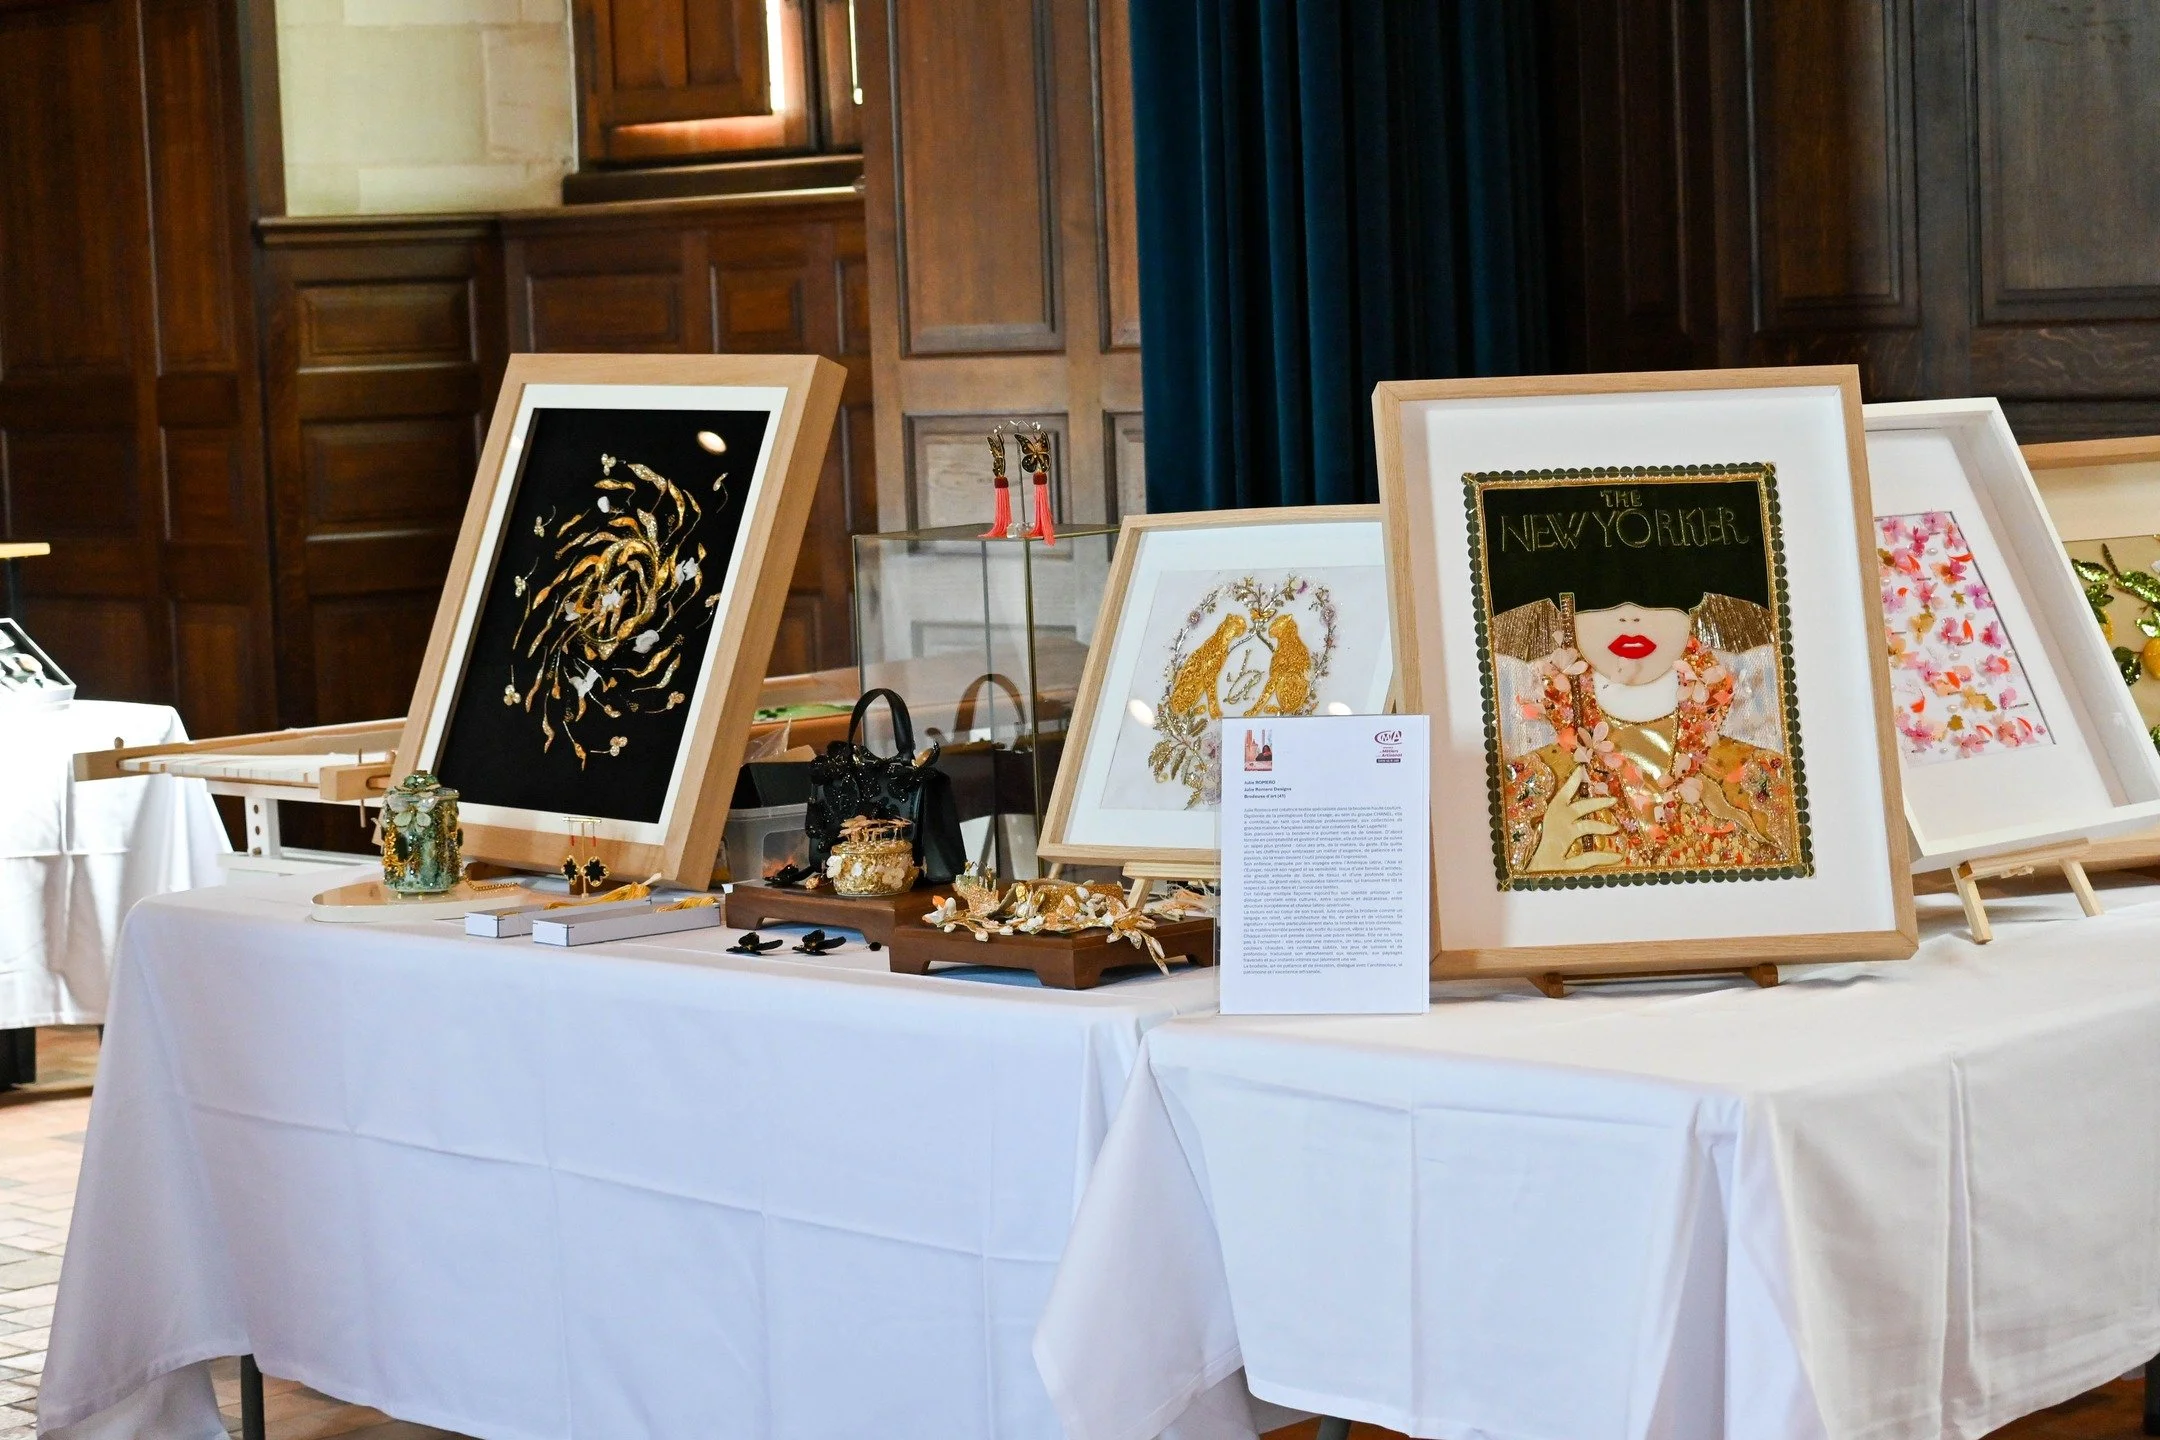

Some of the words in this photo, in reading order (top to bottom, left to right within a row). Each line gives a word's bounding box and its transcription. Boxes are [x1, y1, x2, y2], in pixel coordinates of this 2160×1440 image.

[1600, 489, 1643, 507] THE
[1501, 511, 1589, 552] NEW
[1591, 506, 1749, 549] YORKER
